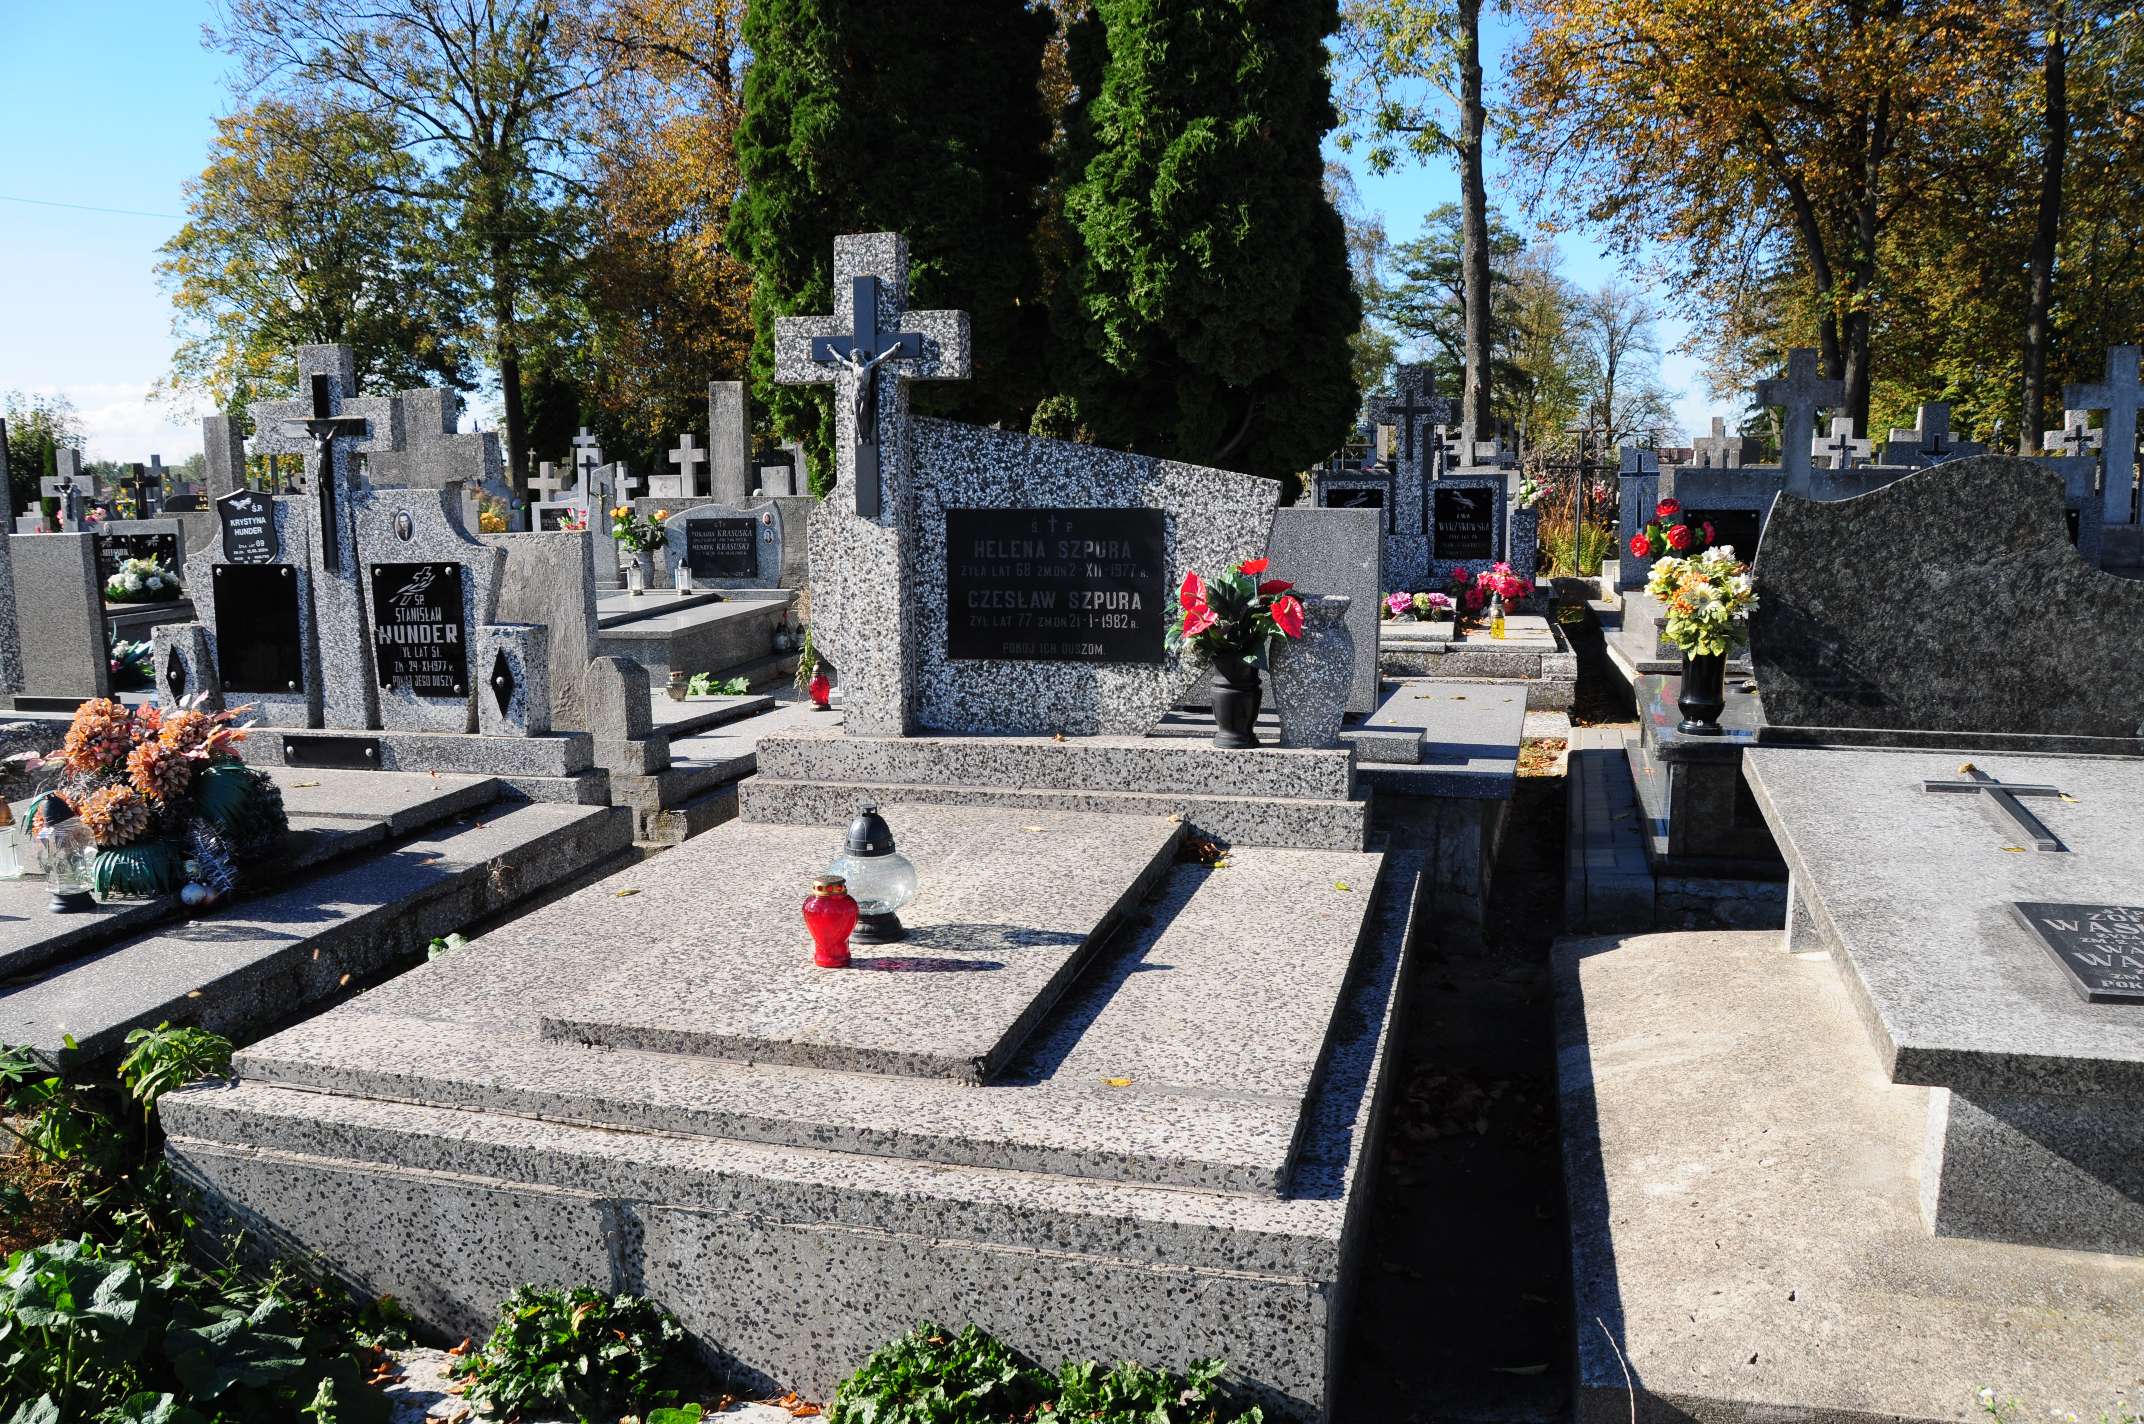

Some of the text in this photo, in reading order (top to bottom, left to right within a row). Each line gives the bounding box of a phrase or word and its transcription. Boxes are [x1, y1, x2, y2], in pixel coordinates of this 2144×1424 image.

[230, 517, 266, 527] KRYSTYNA
[234, 527, 263, 536] HUNDER
[717, 529, 753, 538] KRASUSKA
[716, 542, 751, 551] KRASUSKI
[974, 540, 1132, 560] HELENA SZPURA
[991, 565, 1013, 577] LAT
[1015, 561, 1032, 577] 68
[967, 590, 1143, 610] CZESŁAW SZPURA
[395, 607, 442, 622] STANISŁAW
[992, 615, 1013, 628] LAT
[1016, 612, 1033, 628] 77
[378, 624, 458, 645] HUNDER
[414, 646, 428, 658] LAT
[1040, 642, 1059, 655] ICH
